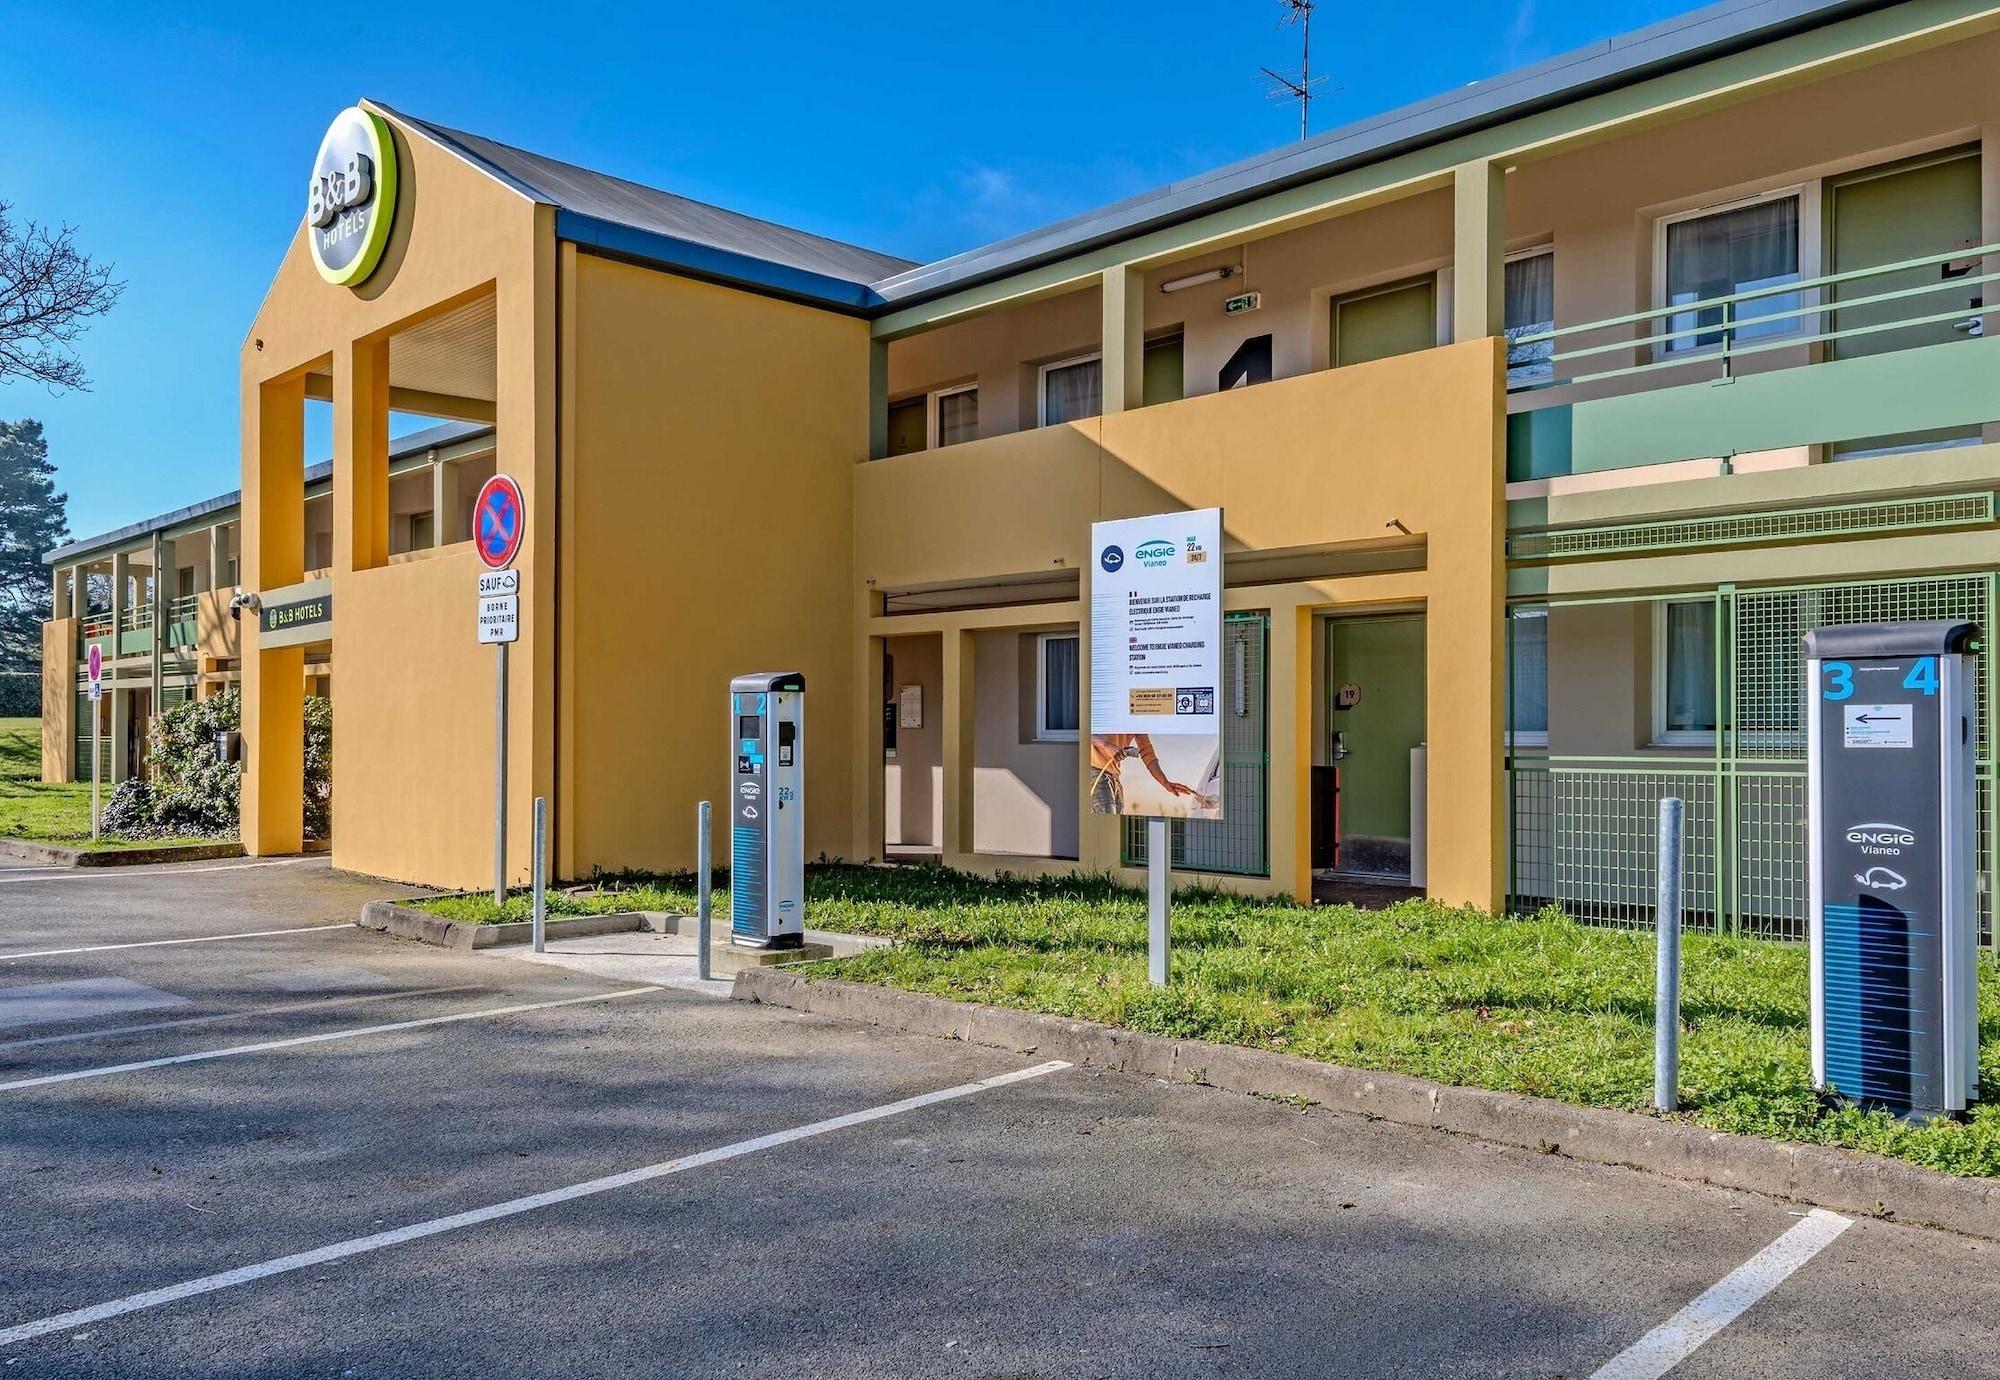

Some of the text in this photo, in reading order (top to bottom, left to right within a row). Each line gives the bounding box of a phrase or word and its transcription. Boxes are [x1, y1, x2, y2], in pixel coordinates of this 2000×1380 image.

[309, 152, 370, 228] B&B
[323, 211, 365, 250] HOTELS
[1186, 542, 1196, 552] 22
[480, 577, 501, 591] SAUF
[279, 603, 323, 624] B&B HOTELS
[486, 602, 508, 612] BORNE
[480, 614, 515, 625] PRIORITAIRE
[490, 627, 504, 637] PMR
[1822, 662, 1855, 701] 3
[1902, 656, 1939, 696] 4
[1345, 690, 1355, 699] 19
[733, 693, 742, 716] 1
[756, 693, 767, 716] 2
[1861, 845, 1900, 856] Vianeo
